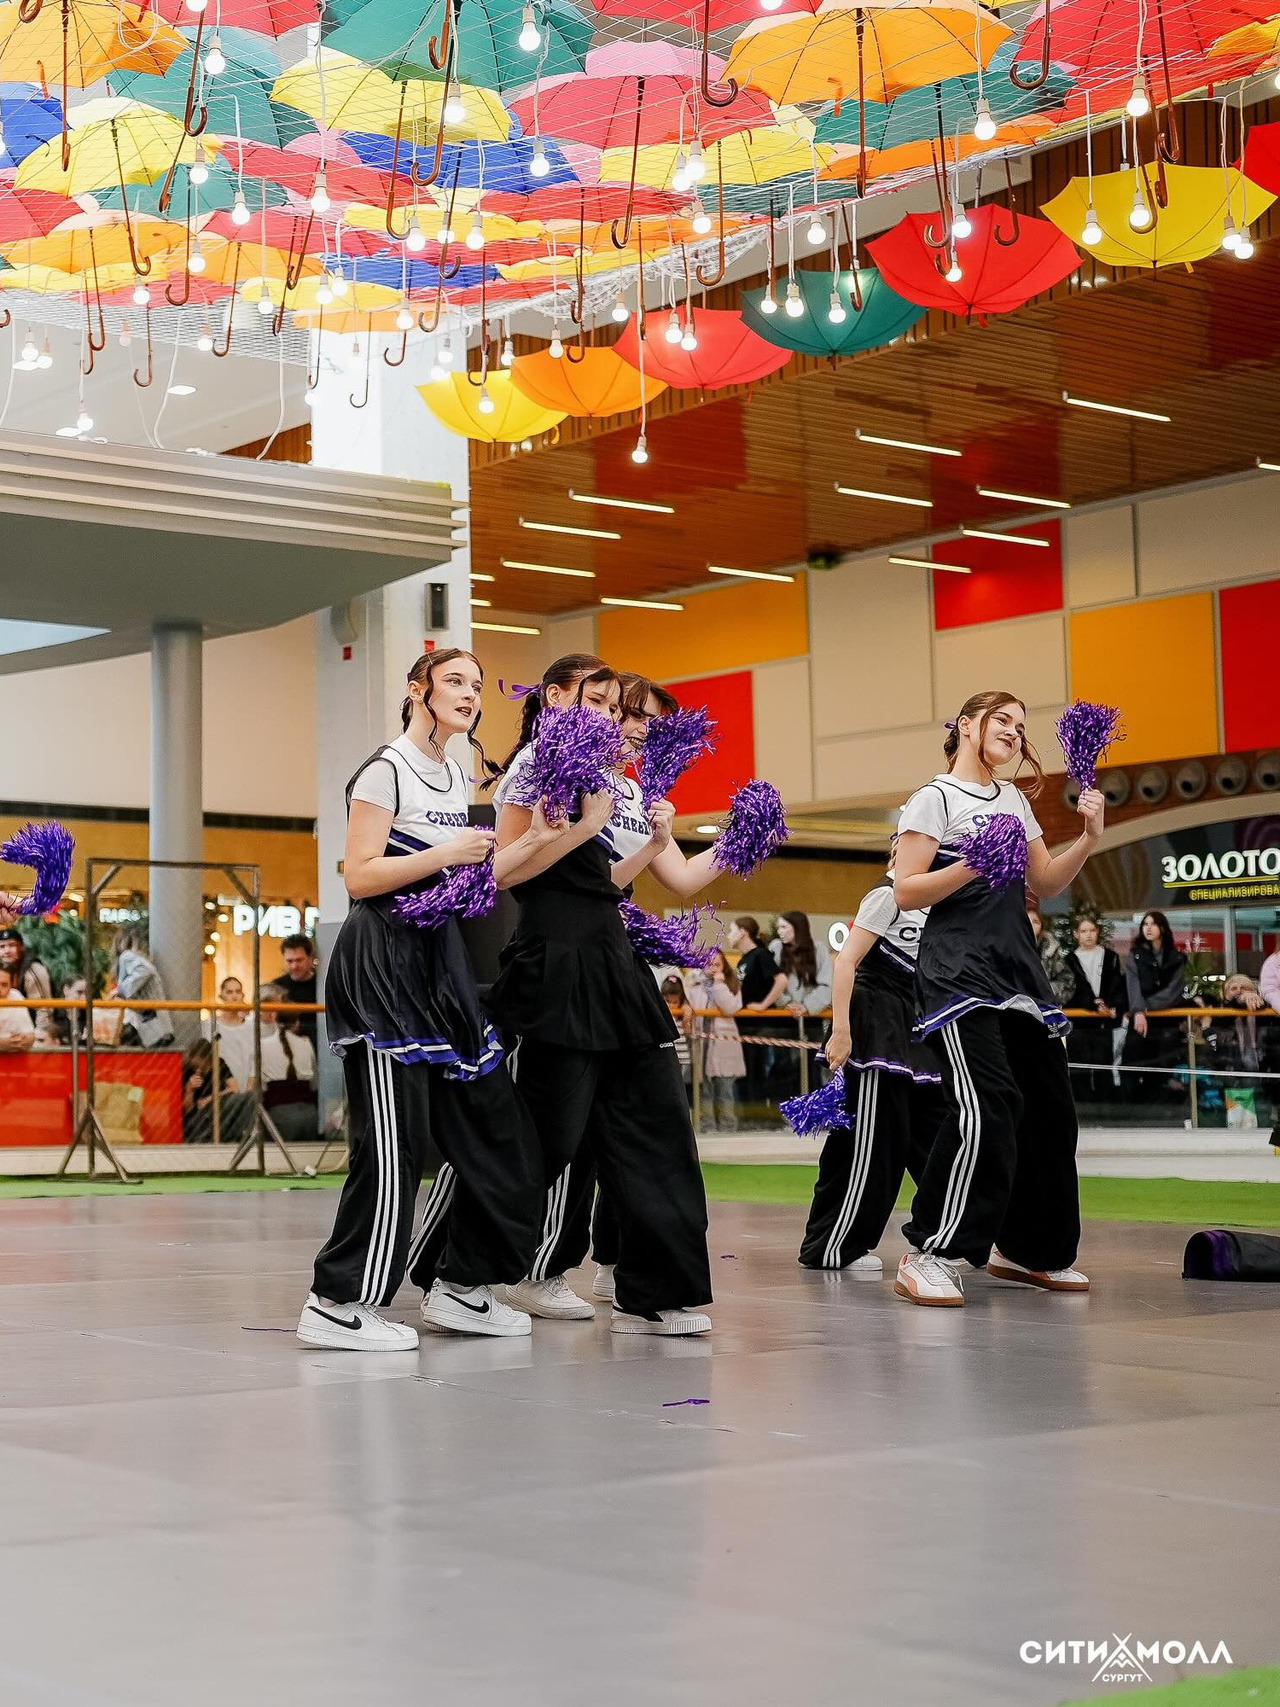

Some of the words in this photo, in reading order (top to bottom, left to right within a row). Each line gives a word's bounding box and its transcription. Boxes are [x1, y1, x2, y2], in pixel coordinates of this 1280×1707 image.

[425, 810, 468, 828] CHEER
[609, 812, 651, 836] CHEE
[1161, 847, 1280, 882] ЗОЛОТО
